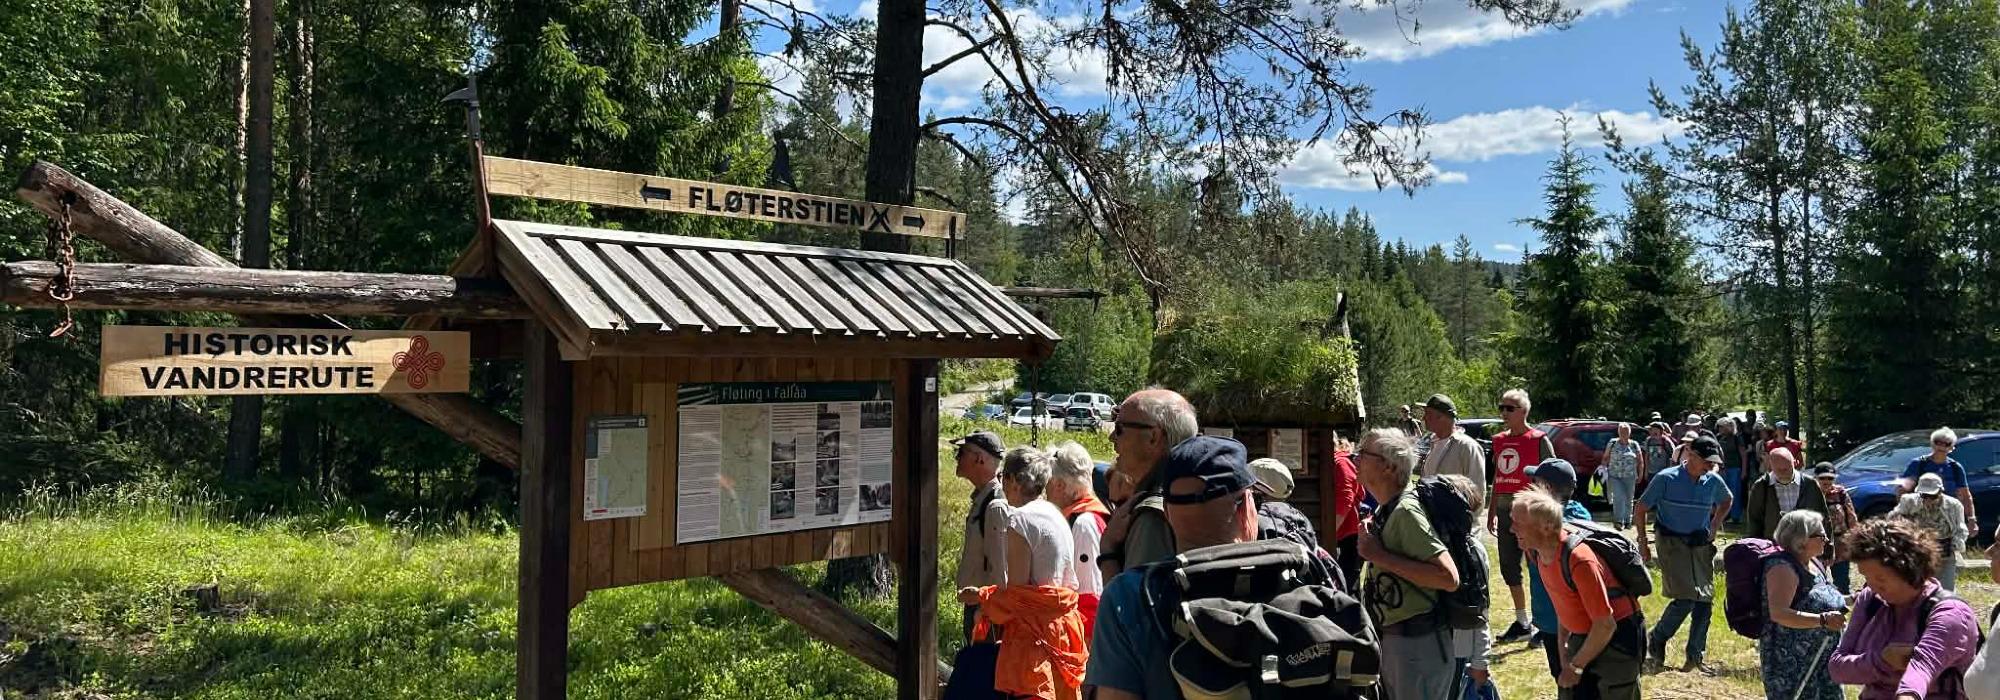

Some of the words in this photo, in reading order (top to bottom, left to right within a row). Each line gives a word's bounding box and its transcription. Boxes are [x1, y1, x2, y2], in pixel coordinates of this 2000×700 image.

[689, 186, 865, 227] FLØTERSTIEN
[163, 332, 353, 356] HISTORISK
[140, 366, 374, 390] VANDRERUTE
